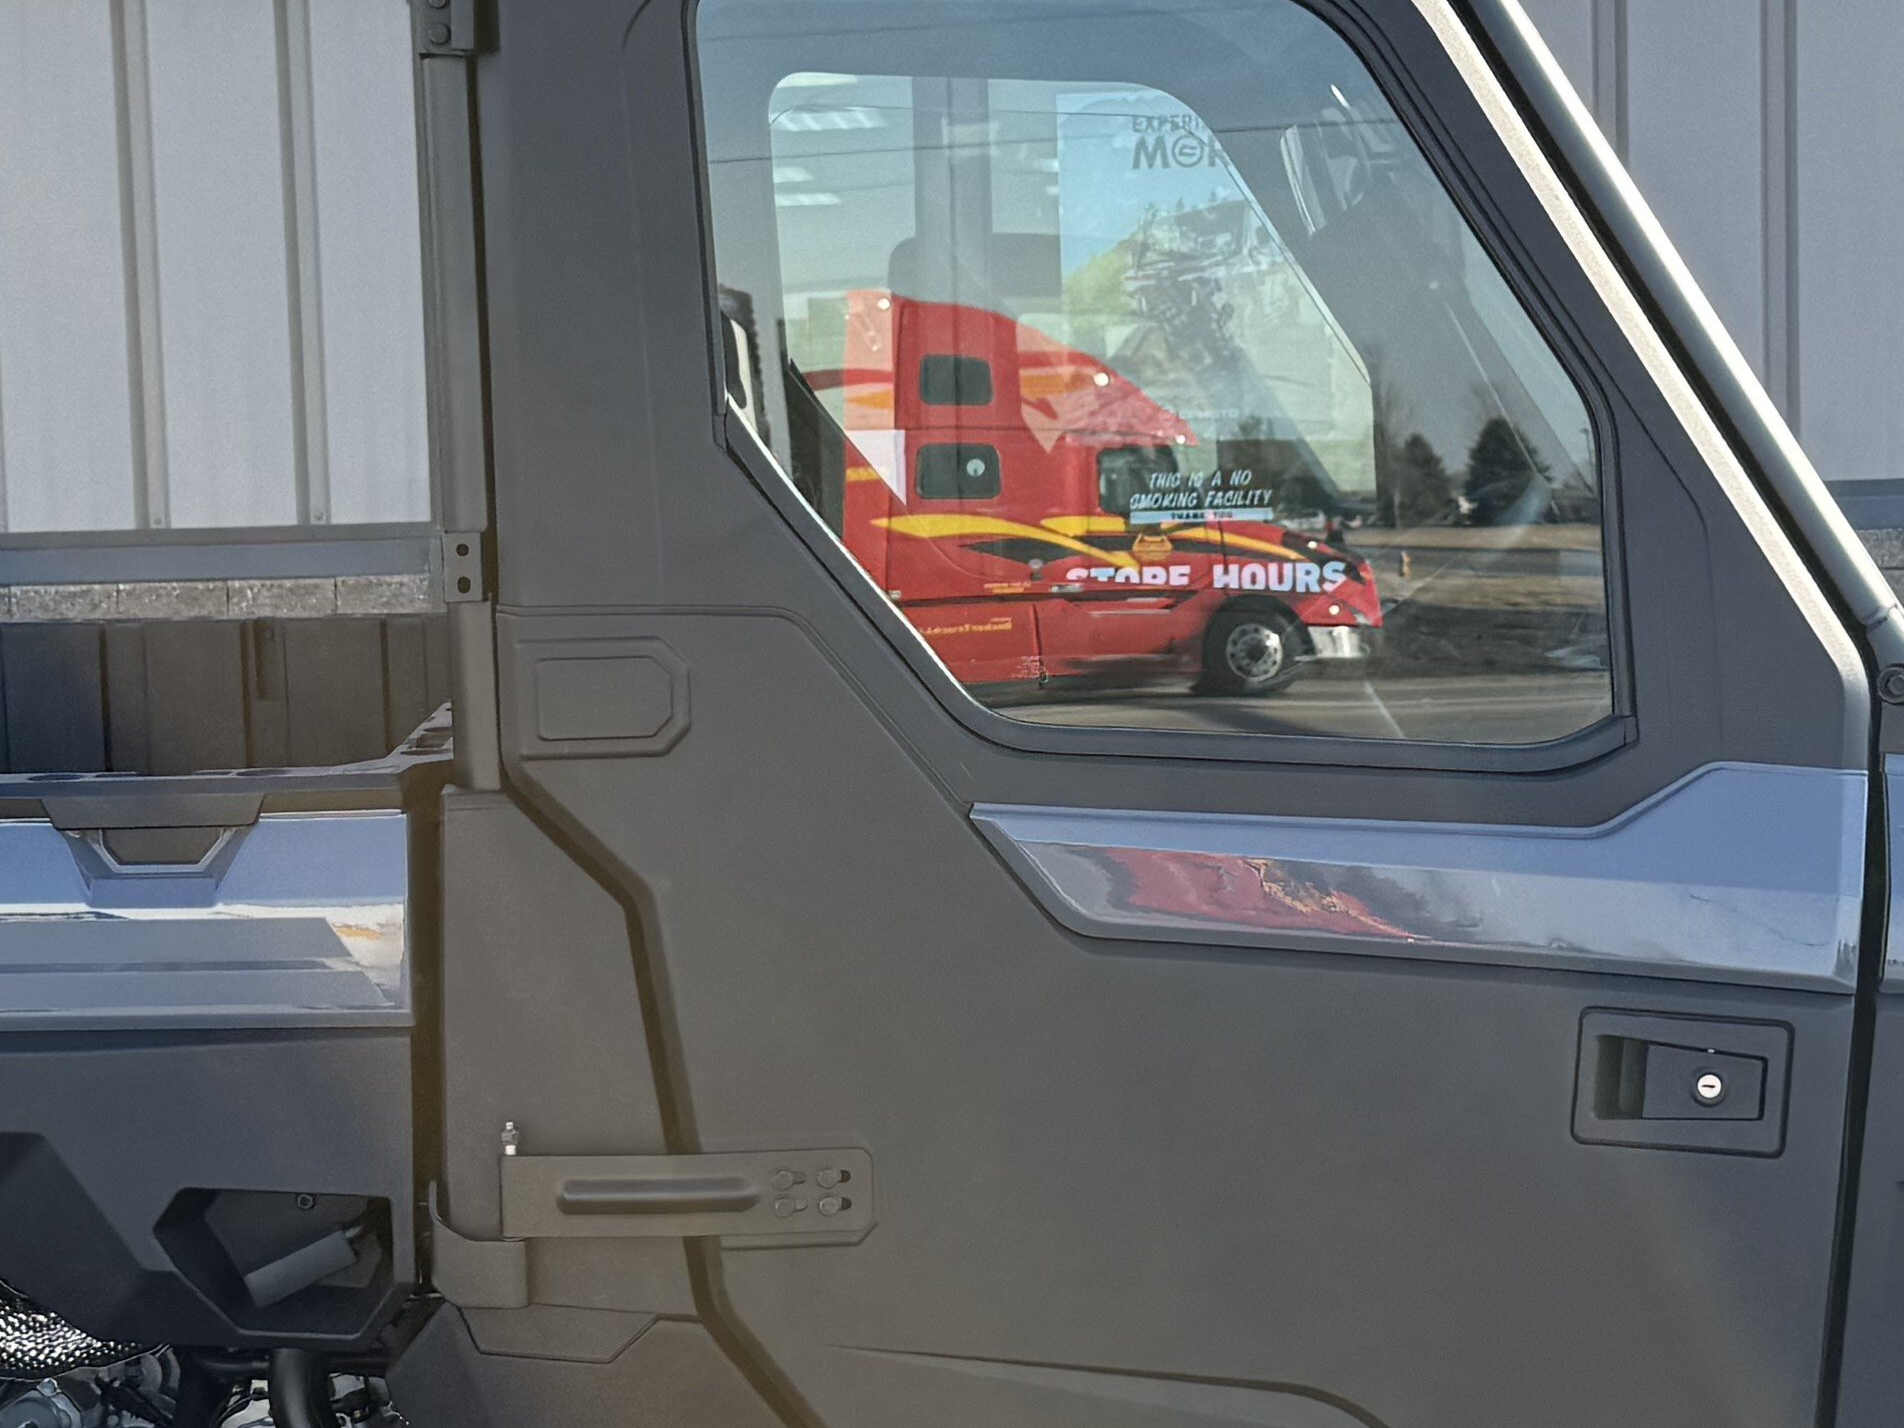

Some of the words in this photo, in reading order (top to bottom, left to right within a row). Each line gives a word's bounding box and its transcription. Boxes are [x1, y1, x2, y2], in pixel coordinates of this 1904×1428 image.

[1149, 472, 1181, 490] THIS
[1188, 471, 1204, 489] IS
[1211, 470, 1222, 487] A
[1229, 469, 1253, 486] NO
[1129, 492, 1198, 510] SMOKING
[1204, 488, 1274, 507] FACILITY
[1212, 561, 1348, 593] HOURS
